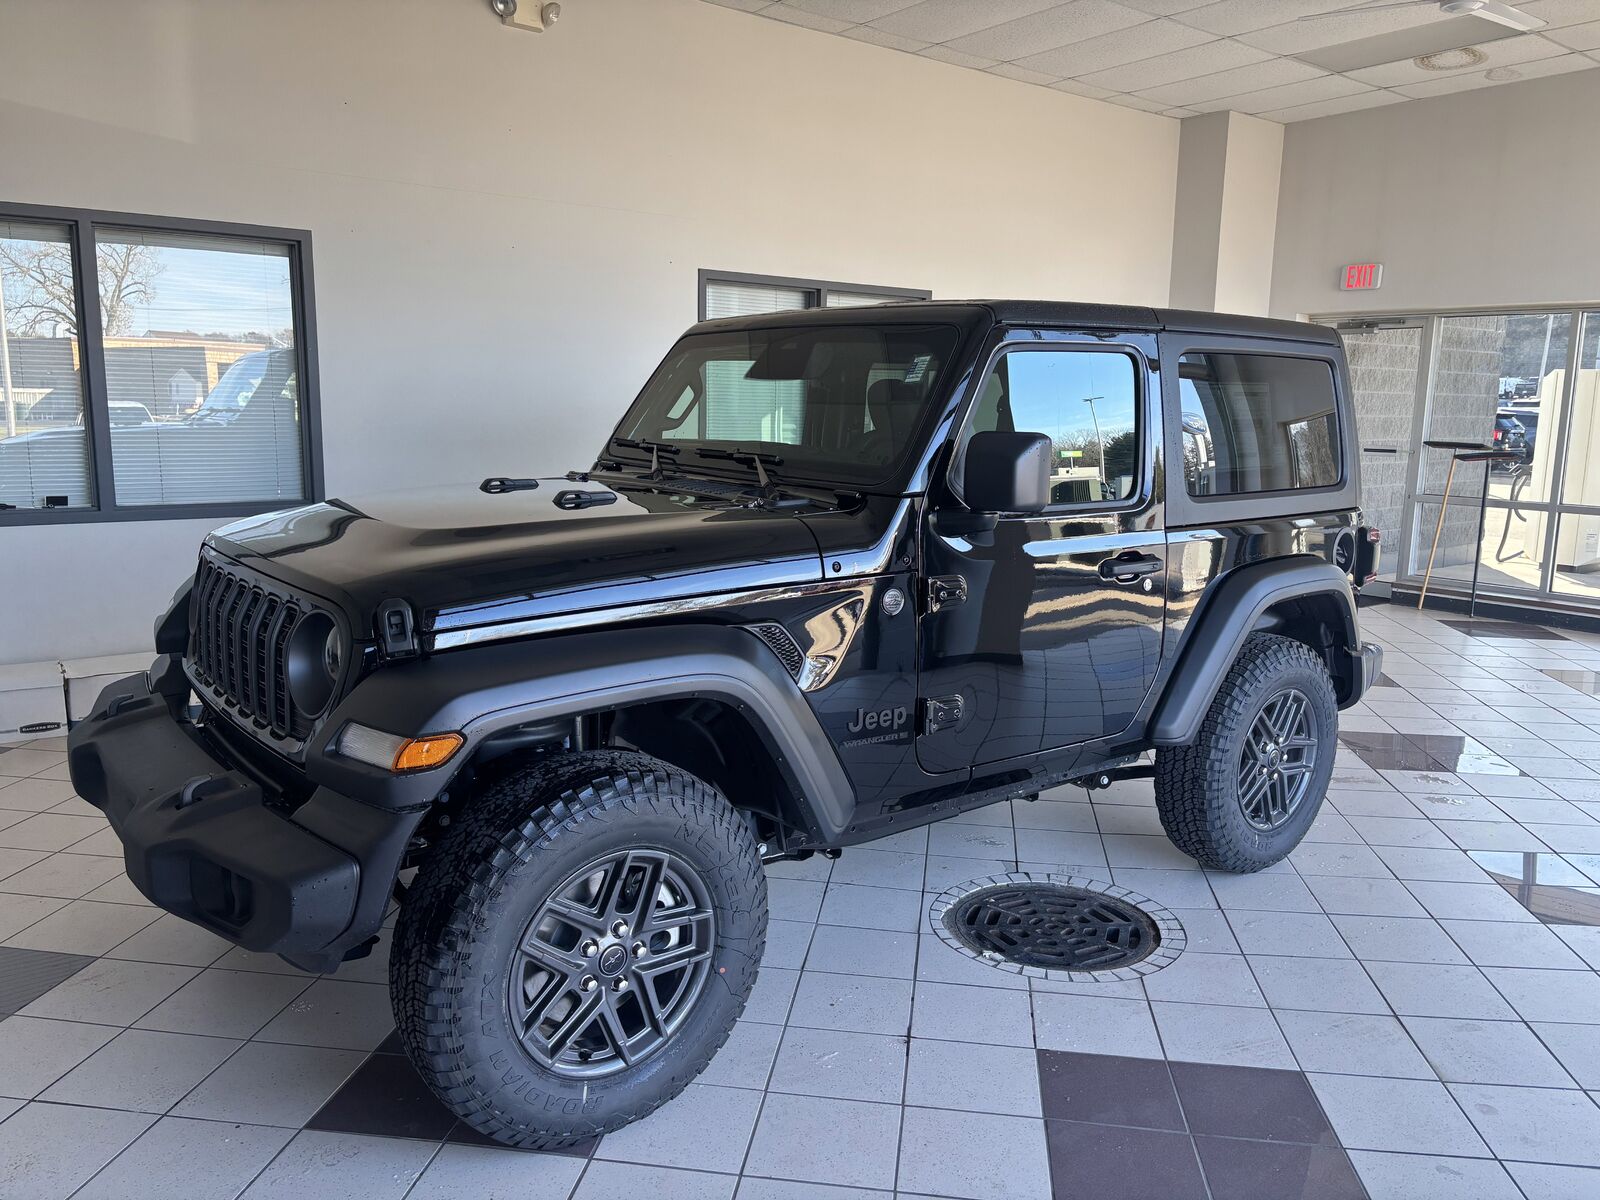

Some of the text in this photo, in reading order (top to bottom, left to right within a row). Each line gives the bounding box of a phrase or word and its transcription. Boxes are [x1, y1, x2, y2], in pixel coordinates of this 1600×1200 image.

[1346, 263, 1376, 288] EXIT
[848, 706, 907, 733] Jeep
[843, 733, 898, 748] WRANGLER
[487, 1048, 604, 1115] ROADIAN
